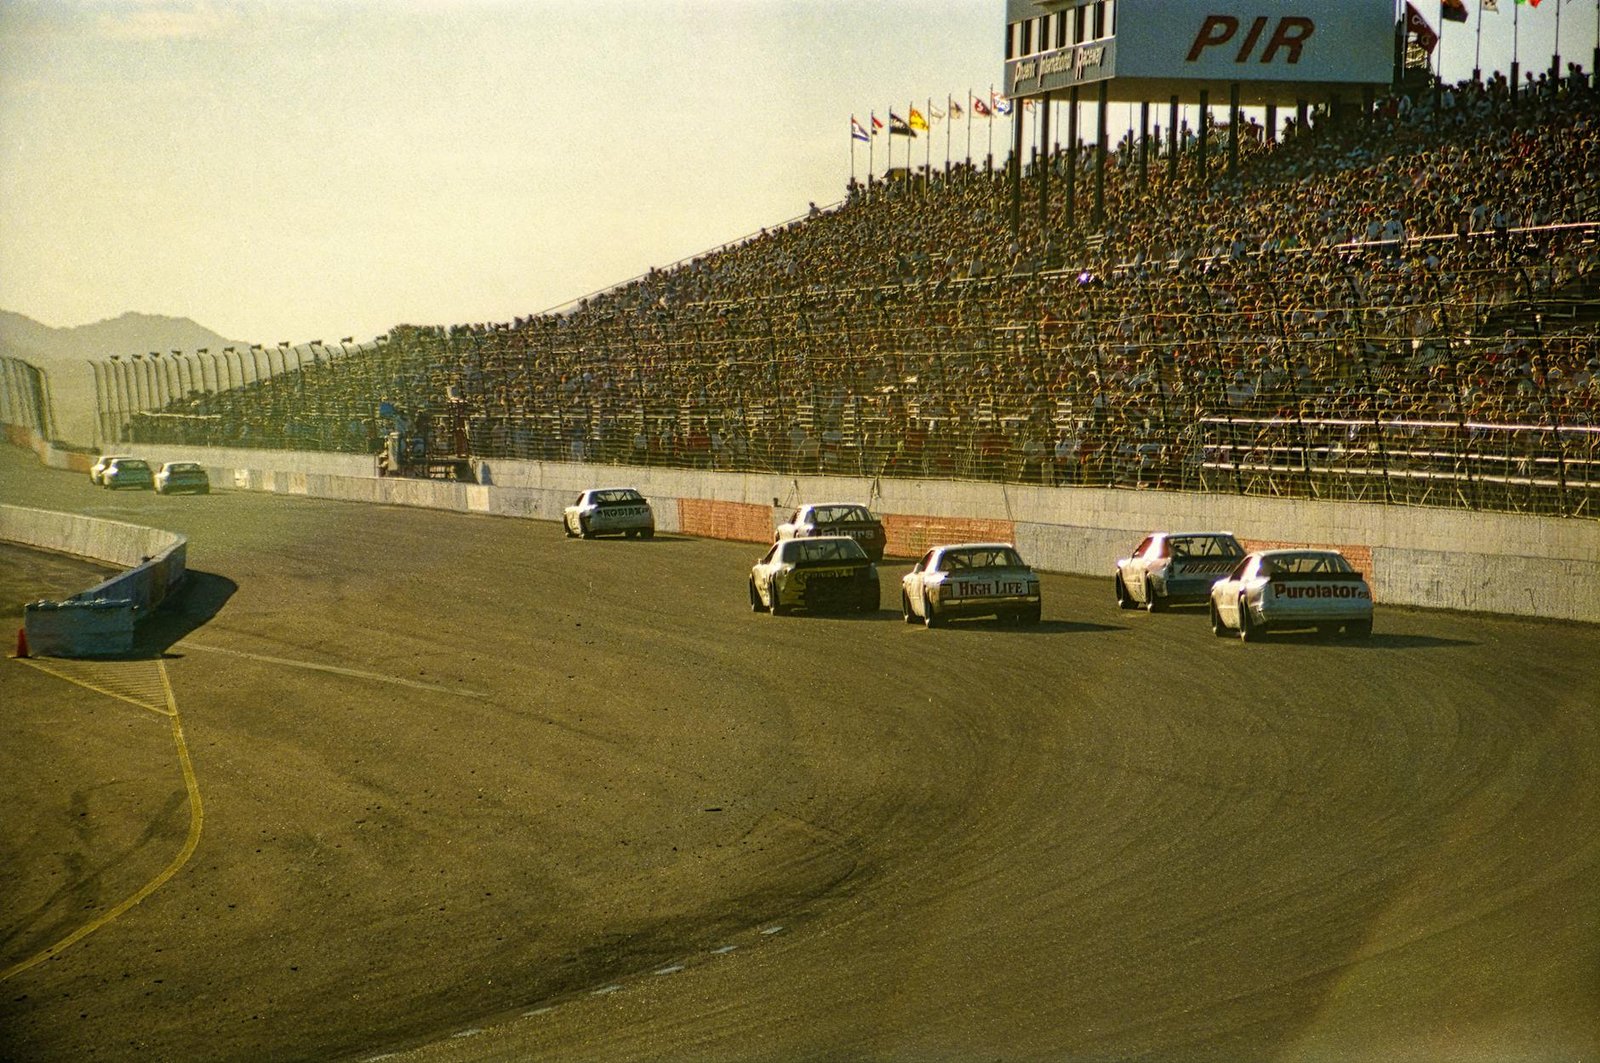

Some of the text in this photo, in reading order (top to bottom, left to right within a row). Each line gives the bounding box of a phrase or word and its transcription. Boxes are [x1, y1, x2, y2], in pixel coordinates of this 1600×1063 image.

[1186, 15, 1315, 64] PIR
[959, 580, 1023, 596] HIGH LIFE
[1274, 583, 1359, 599] Purolator
